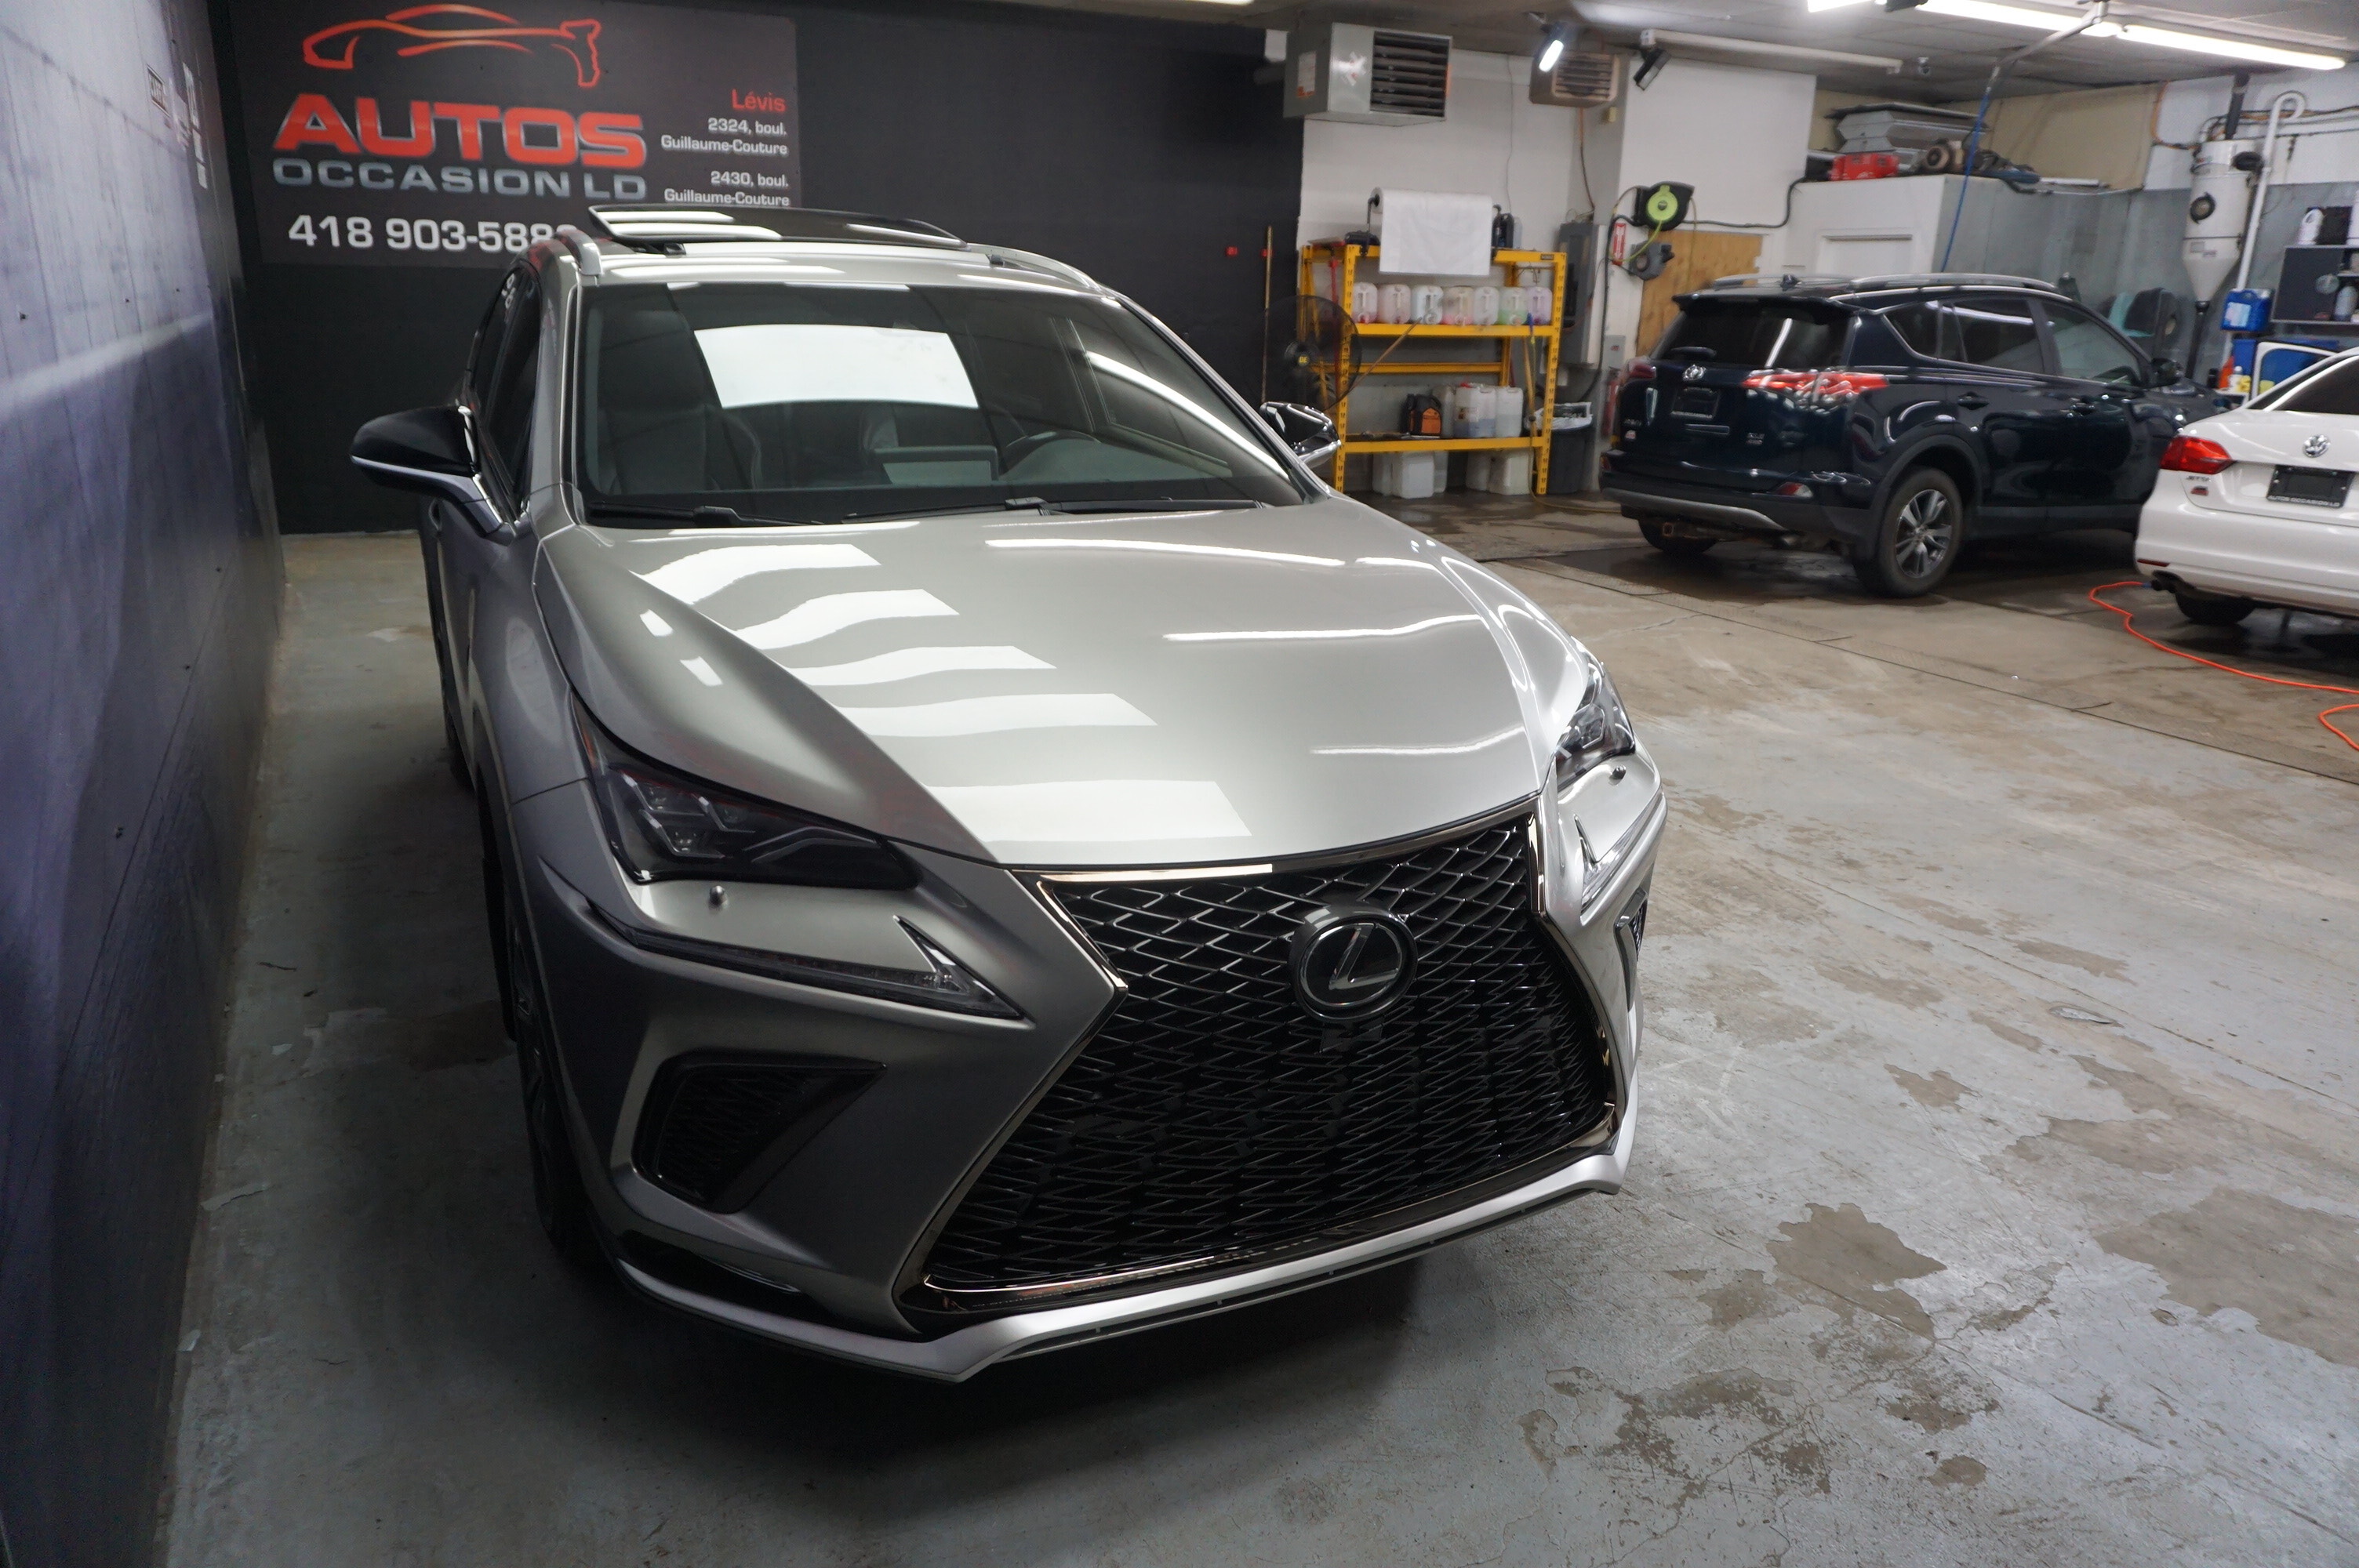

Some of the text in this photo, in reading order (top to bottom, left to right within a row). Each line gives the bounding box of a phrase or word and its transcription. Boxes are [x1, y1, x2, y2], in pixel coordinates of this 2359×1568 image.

[731, 89, 787, 112] Lévis
[273, 93, 647, 169] AUTOS
[707, 118, 787, 136] 2324, boul.
[660, 135, 788, 155] Guillaume-Couture
[272, 158, 647, 200] OCCASION LD
[711, 170, 789, 187] 2430, boul.
[663, 188, 791, 206] Guillaume-Couture
[288, 215, 579, 252] 418 903-588
